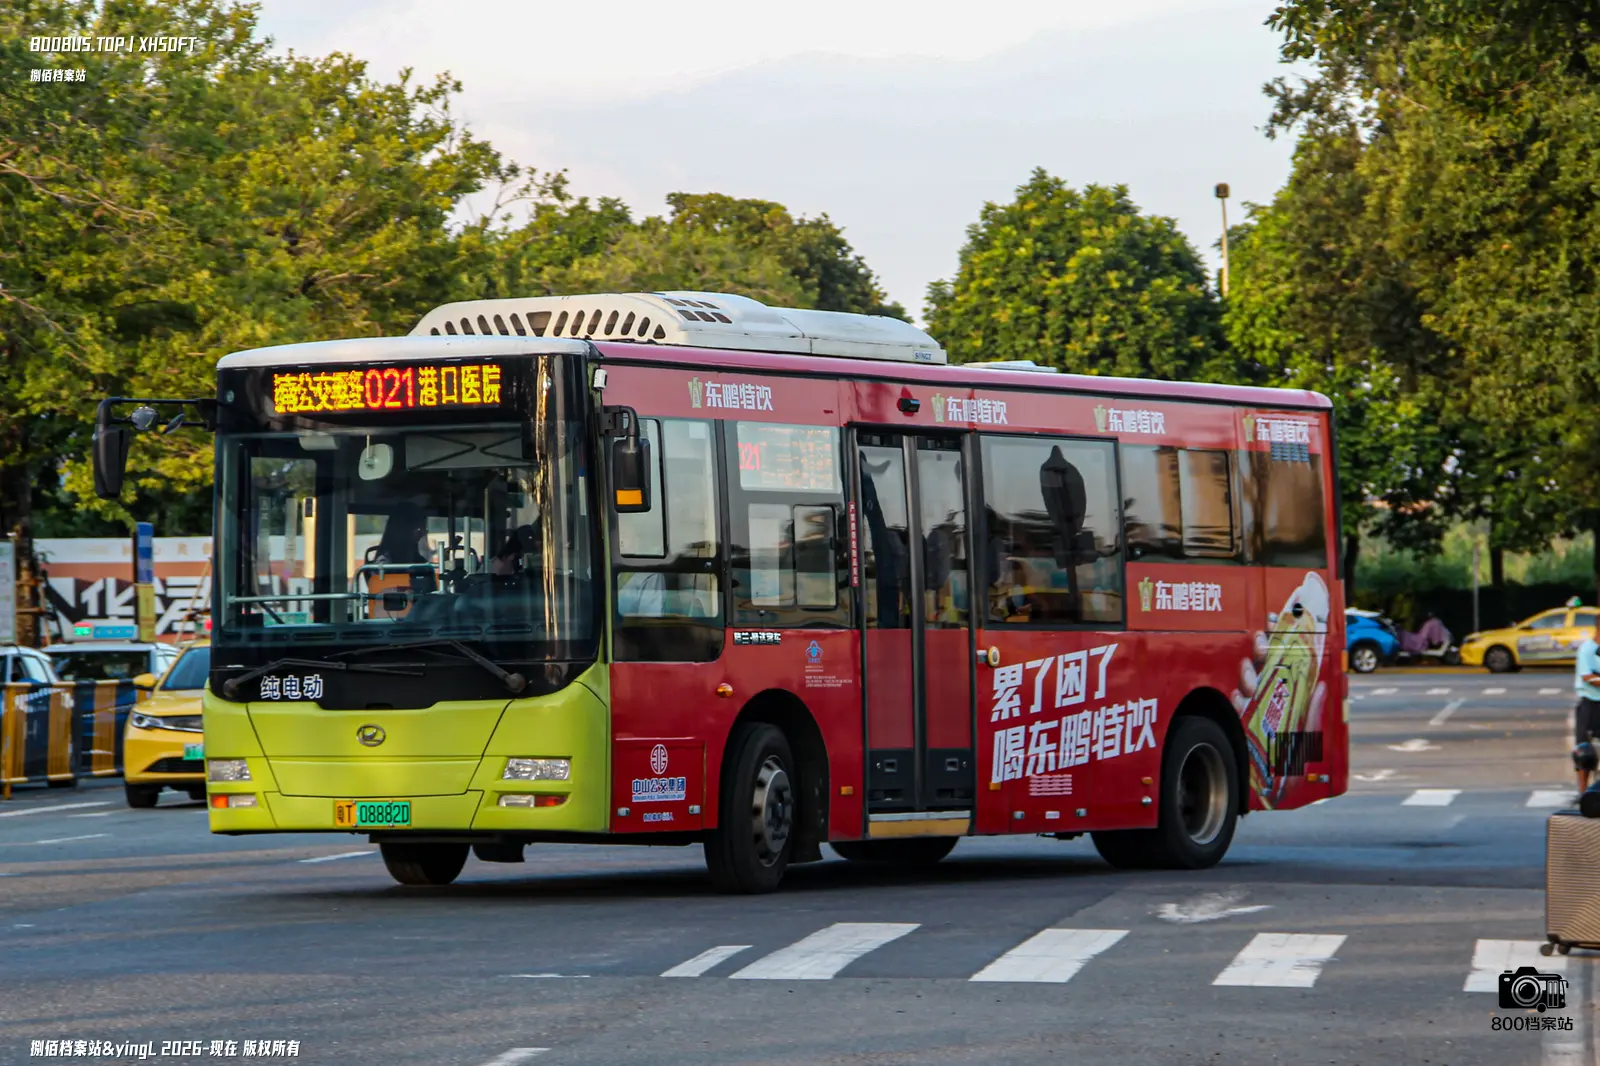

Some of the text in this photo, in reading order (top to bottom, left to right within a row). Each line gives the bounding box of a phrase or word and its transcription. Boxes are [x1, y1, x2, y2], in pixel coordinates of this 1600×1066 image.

[364, 368, 415, 409] 021
[418, 364, 501, 407] 港口医院
[704, 380, 774, 411] 东鹏特饮
[947, 396, 1008, 424] 东鹏特饮
[1108, 407, 1166, 435] 东鹏特饮
[1155, 580, 1223, 612] 东鹏特饮
[260, 674, 323, 699] 纯电动
[991, 643, 1118, 722] 累了困了
[991, 697, 1158, 784] 喝东鹏特饮
